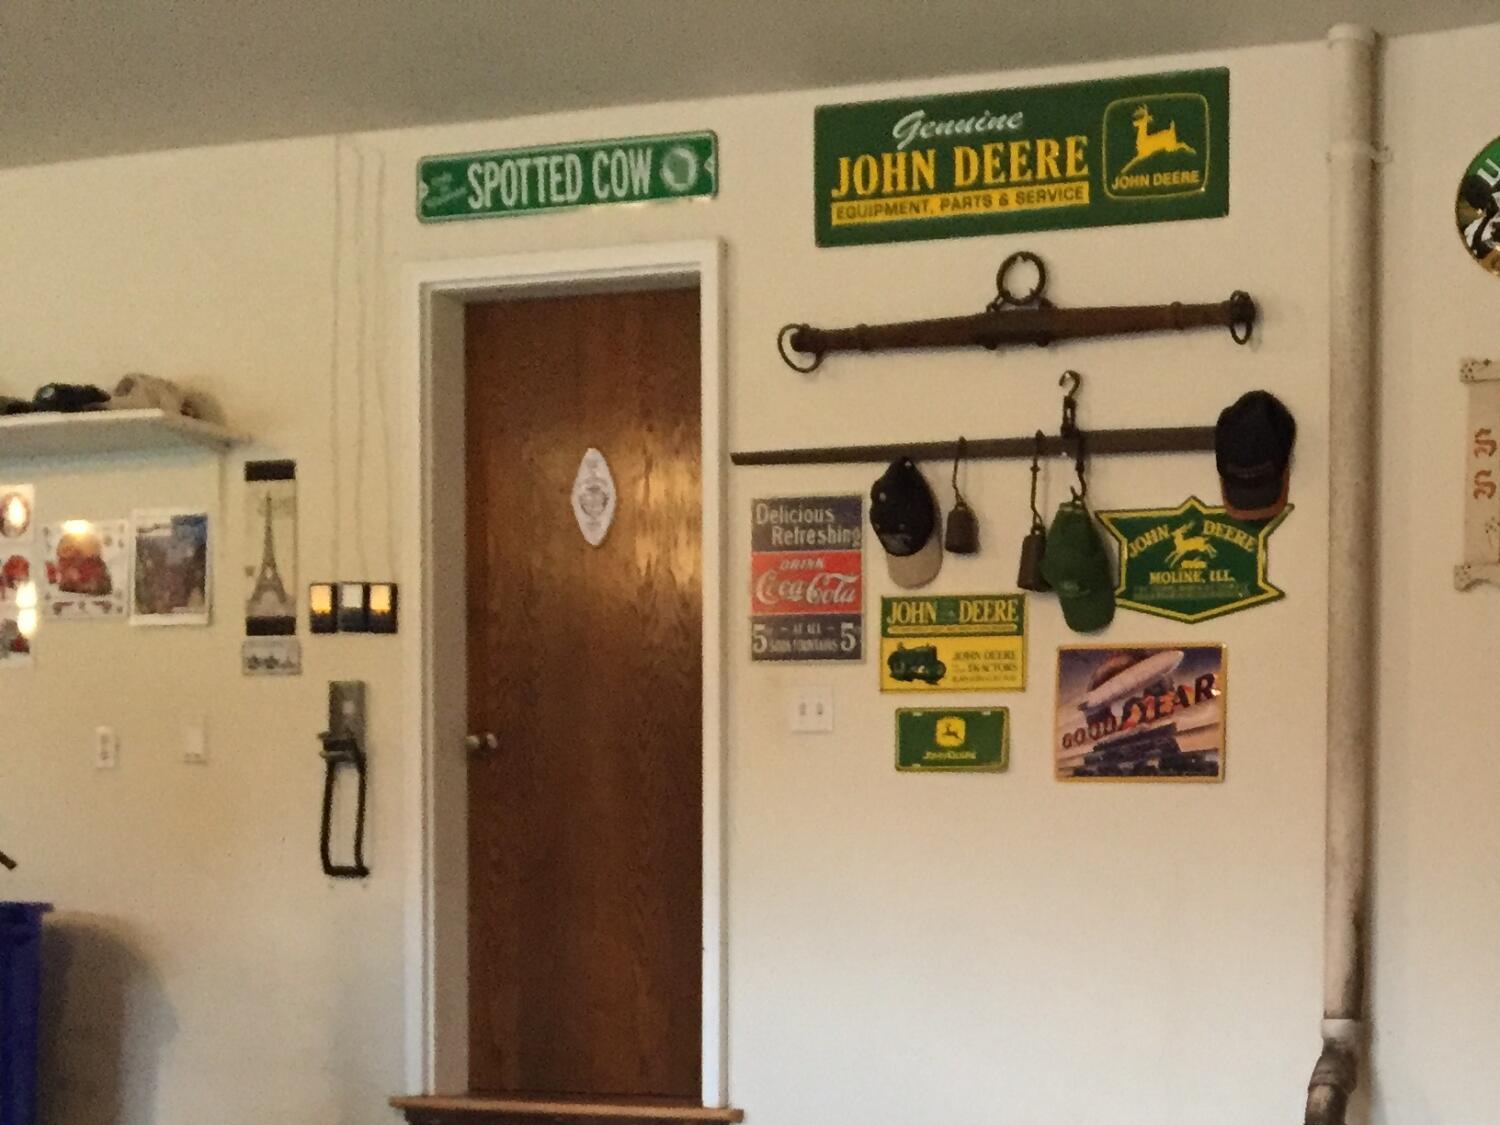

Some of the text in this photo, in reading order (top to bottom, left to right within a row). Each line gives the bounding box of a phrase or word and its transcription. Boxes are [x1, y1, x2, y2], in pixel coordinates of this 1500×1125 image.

[892, 110, 1024, 150] Genuine
[467, 153, 583, 210] SPOTTED
[592, 149, 653, 199] COW
[831, 135, 1089, 197] JOHN DEERE
[1112, 170, 1200, 190] JOHN DEERE
[836, 186, 1085, 221] EQUIPMENT, PARTS & SERVICE
[756, 503, 835, 525] Delicious
[772, 525, 861, 547] Refreshing
[1128, 520, 1257, 558] JOHN DEERE
[887, 600, 1018, 624] JOHN DEERE
